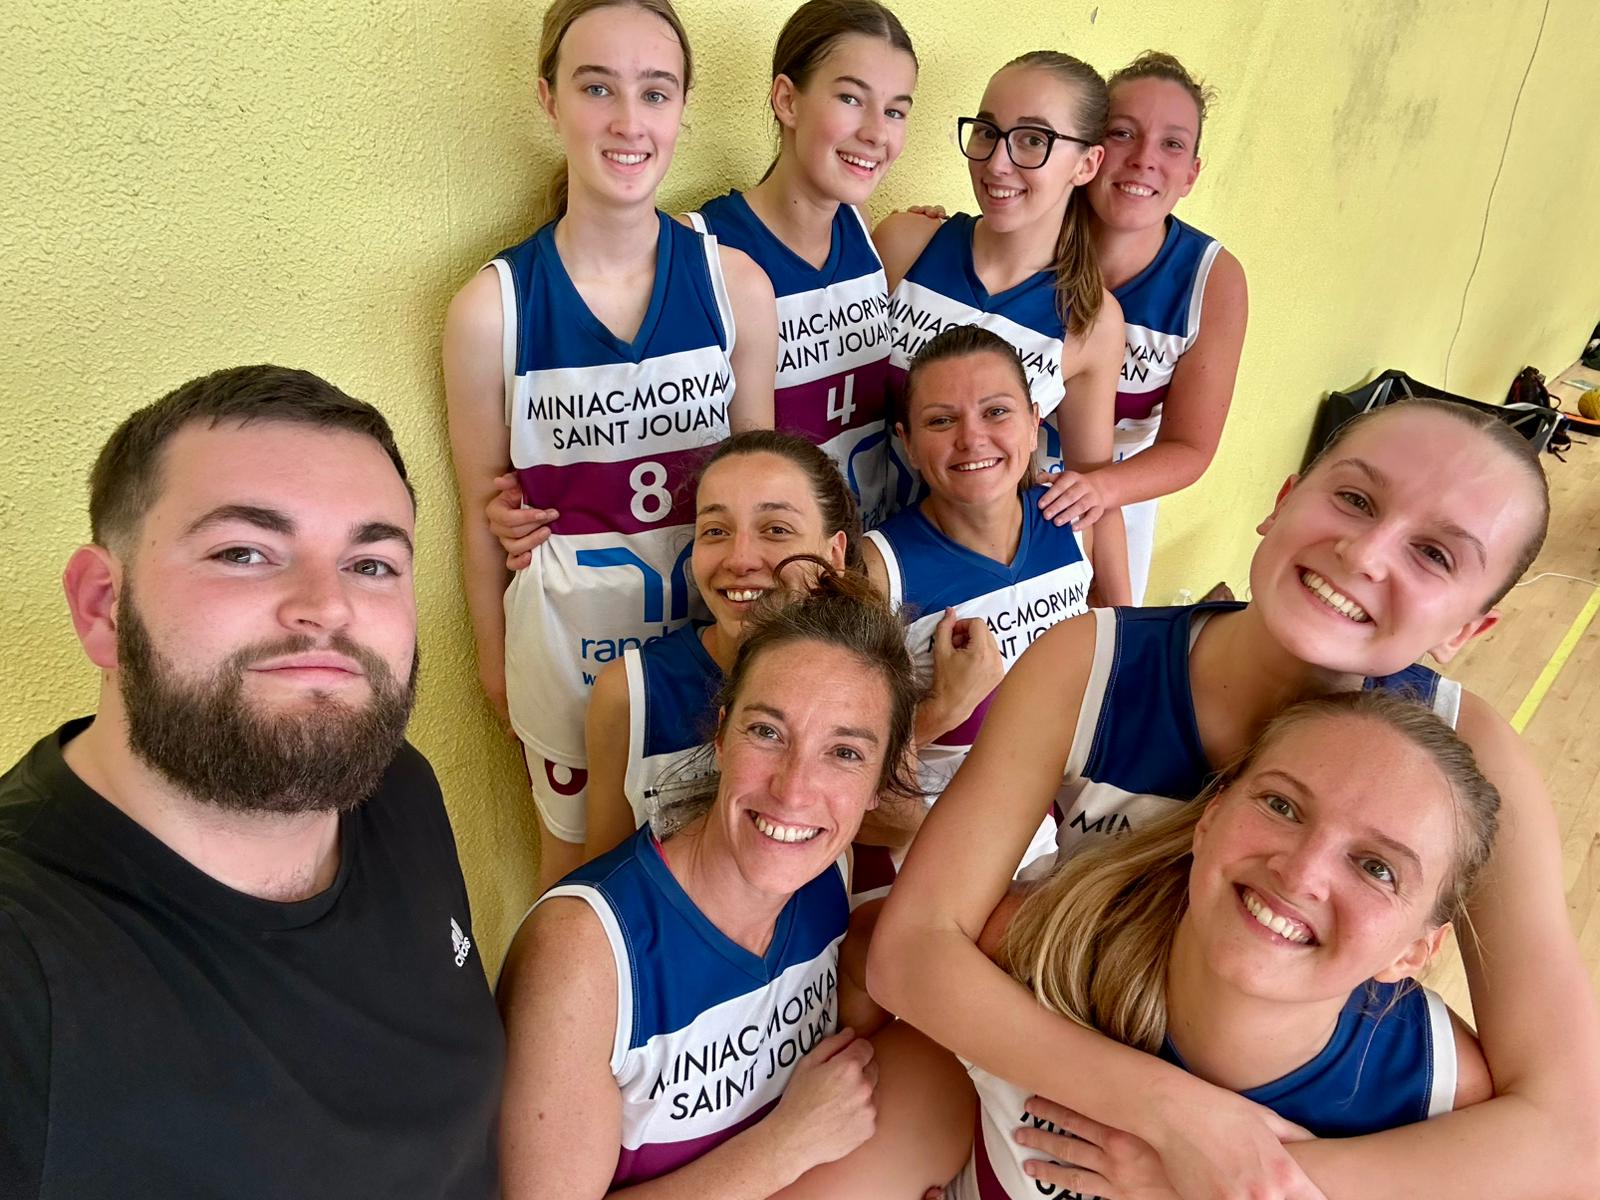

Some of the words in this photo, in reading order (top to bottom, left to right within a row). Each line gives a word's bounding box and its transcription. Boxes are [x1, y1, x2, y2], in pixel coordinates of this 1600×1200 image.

[775, 340, 829, 373] AINT
[553, 420, 629, 450] SAINT
[637, 402, 725, 440] JOUAN
[826, 374, 857, 426] 4
[629, 461, 673, 523] 8
[670, 1058, 758, 1120] SAINT
